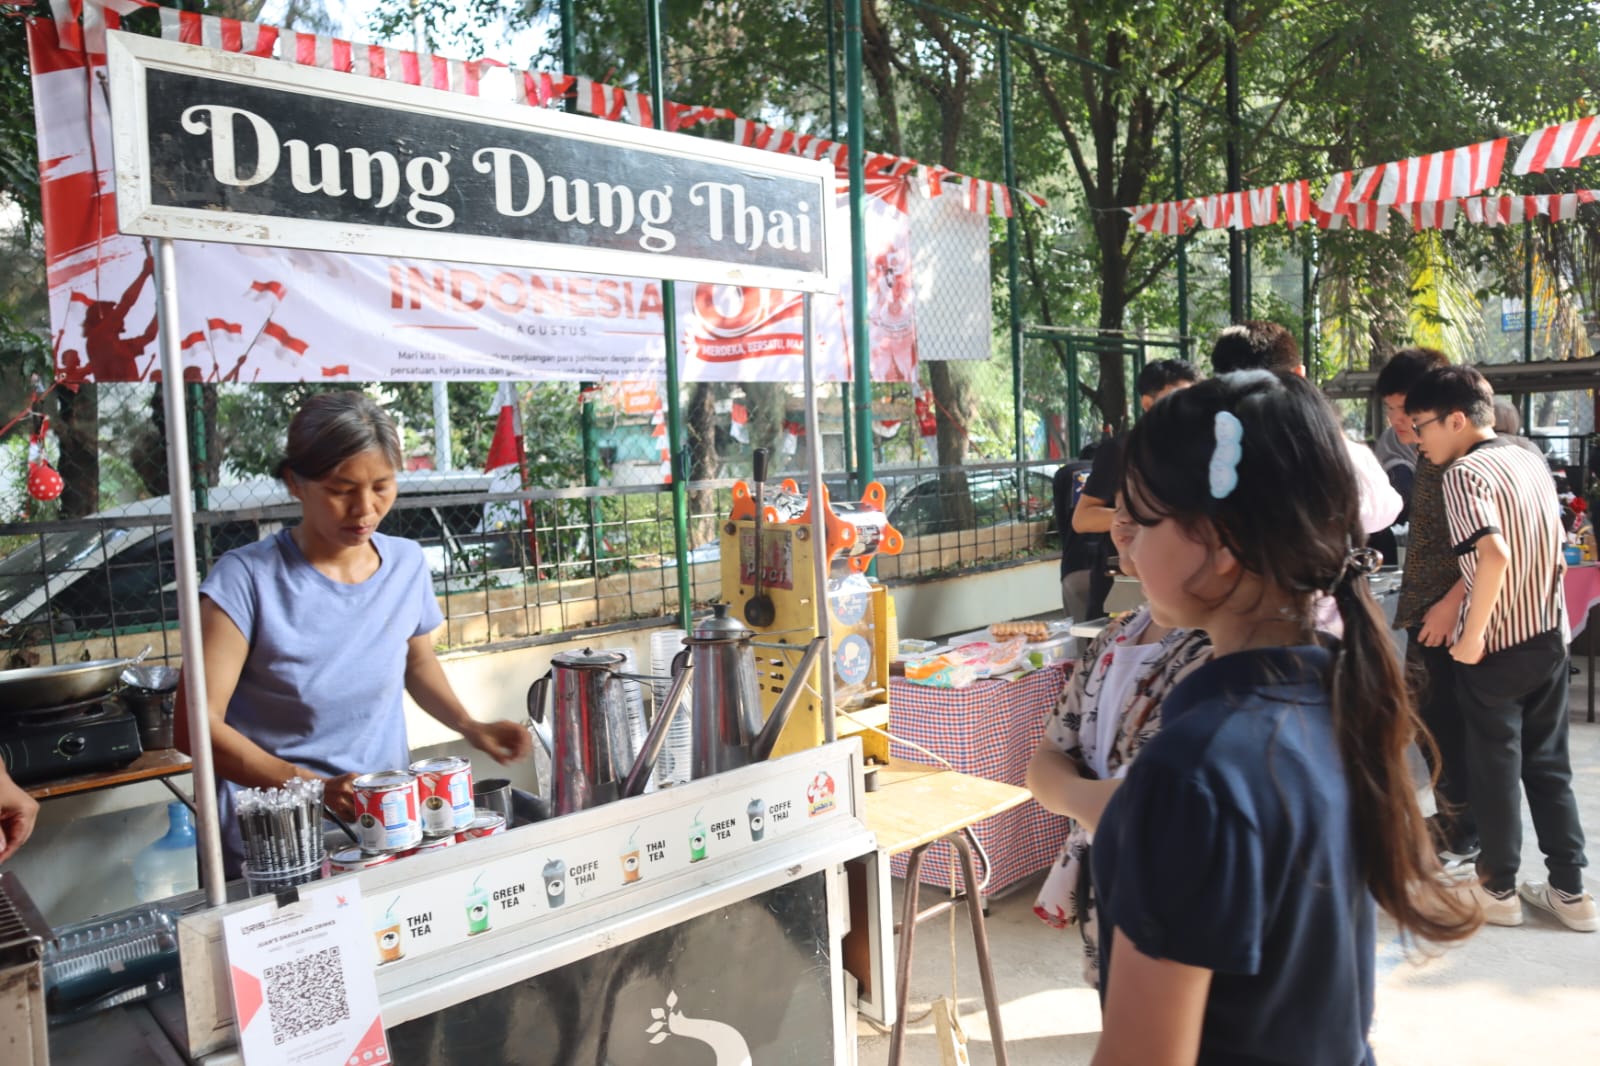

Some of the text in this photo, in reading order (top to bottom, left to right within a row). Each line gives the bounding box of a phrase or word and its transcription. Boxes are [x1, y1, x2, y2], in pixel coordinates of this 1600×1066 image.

[181, 104, 812, 254] Dung Dung Thai
[387, 265, 664, 321] INDONESIA
[517, 323, 588, 337] AGUSTUS
[511, 351, 555, 364] perjuangan
[769, 800, 792, 815] COFFE
[773, 810, 789, 823] THAI
[710, 818, 736, 834] GREEN
[716, 829, 731, 841] TEA
[646, 839, 666, 853] THAI
[649, 851, 665, 862] TEA
[569, 860, 599, 877] COFFE
[574, 872, 596, 886] THAI
[493, 882, 525, 901] GREEN
[500, 896, 520, 910] TEA
[406, 911, 432, 928] THAI
[410, 924, 432, 939] TEA
